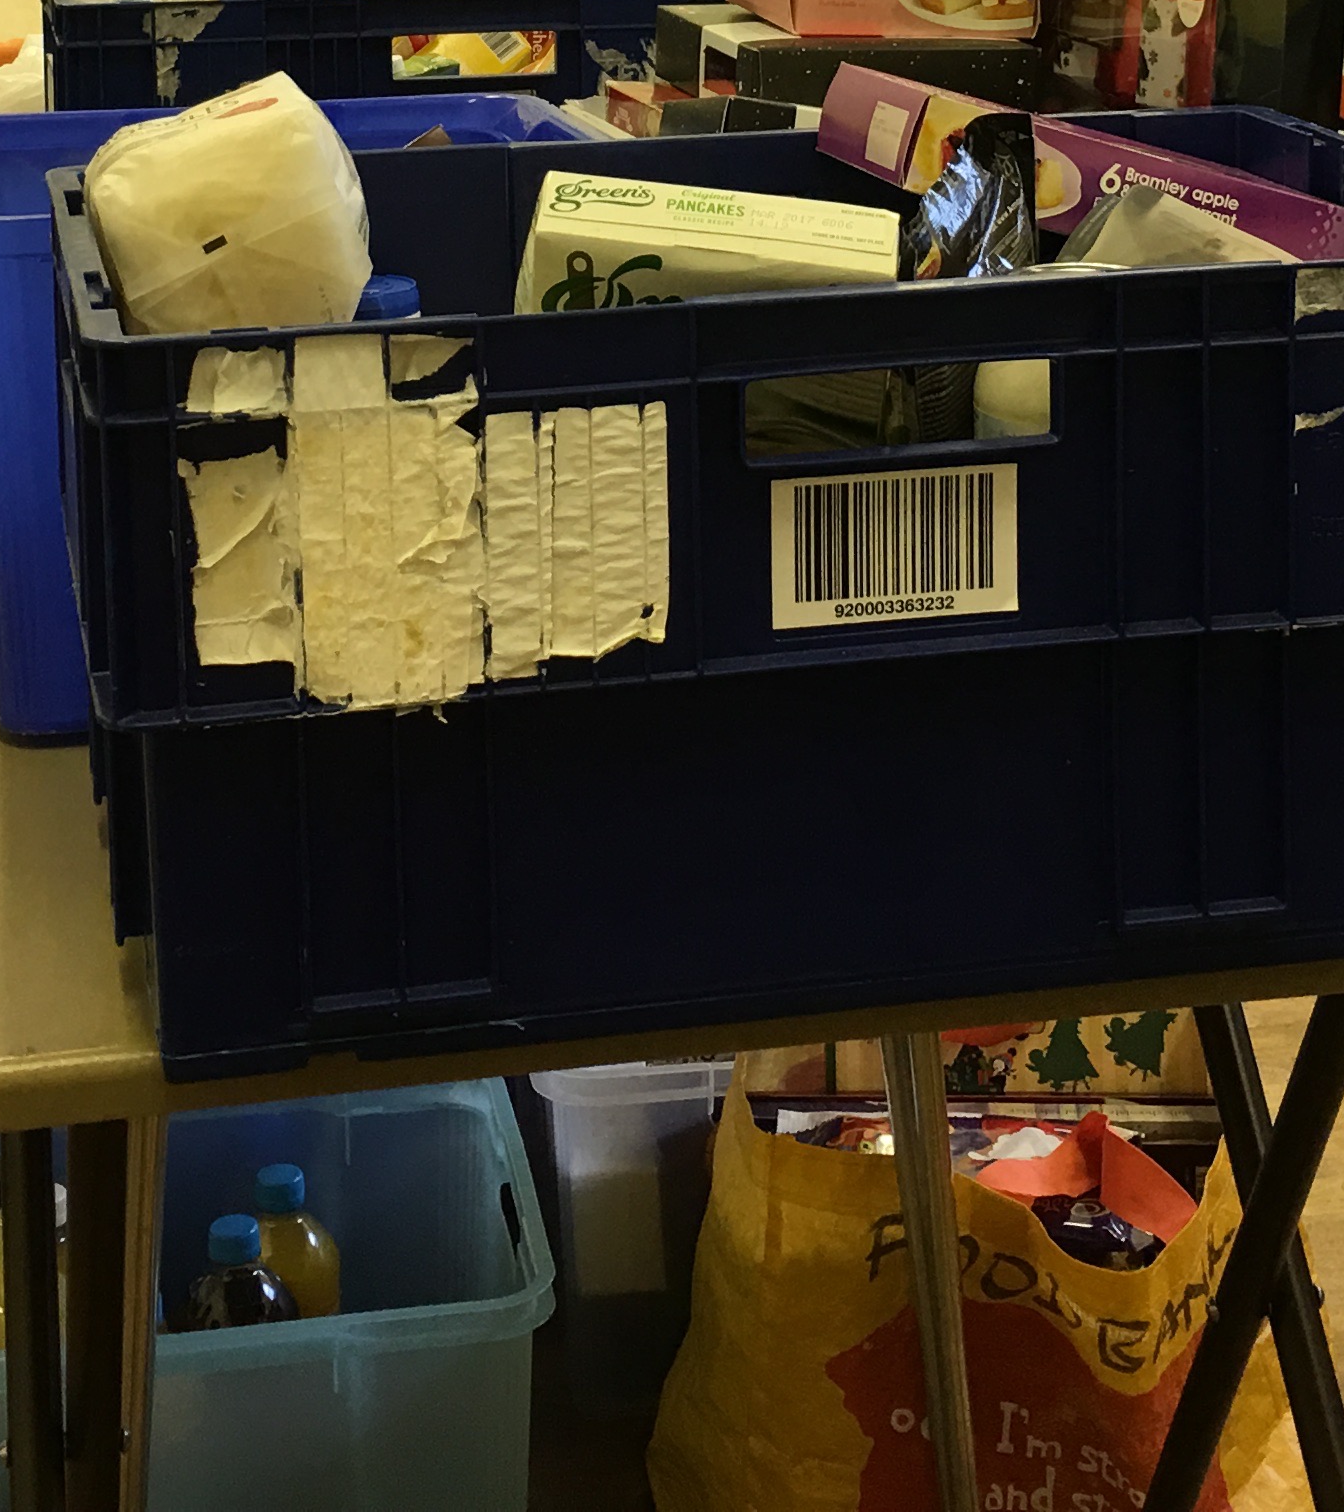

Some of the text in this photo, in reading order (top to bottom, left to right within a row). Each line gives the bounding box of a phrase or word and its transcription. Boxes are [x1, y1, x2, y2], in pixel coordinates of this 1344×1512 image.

[681, 189, 736, 202] Original
[1100, 162, 1240, 211] 6 Bramley apple
[666, 198, 745, 217] PANCAKES
[783, 212, 815, 224] 2017
[673, 215, 735, 226] CLASSIC RECIPE
[834, 595, 955, 618] 920003363232
[996, 1401, 1062, 1458] I'm
[984, 1465, 1056, 1511] and
